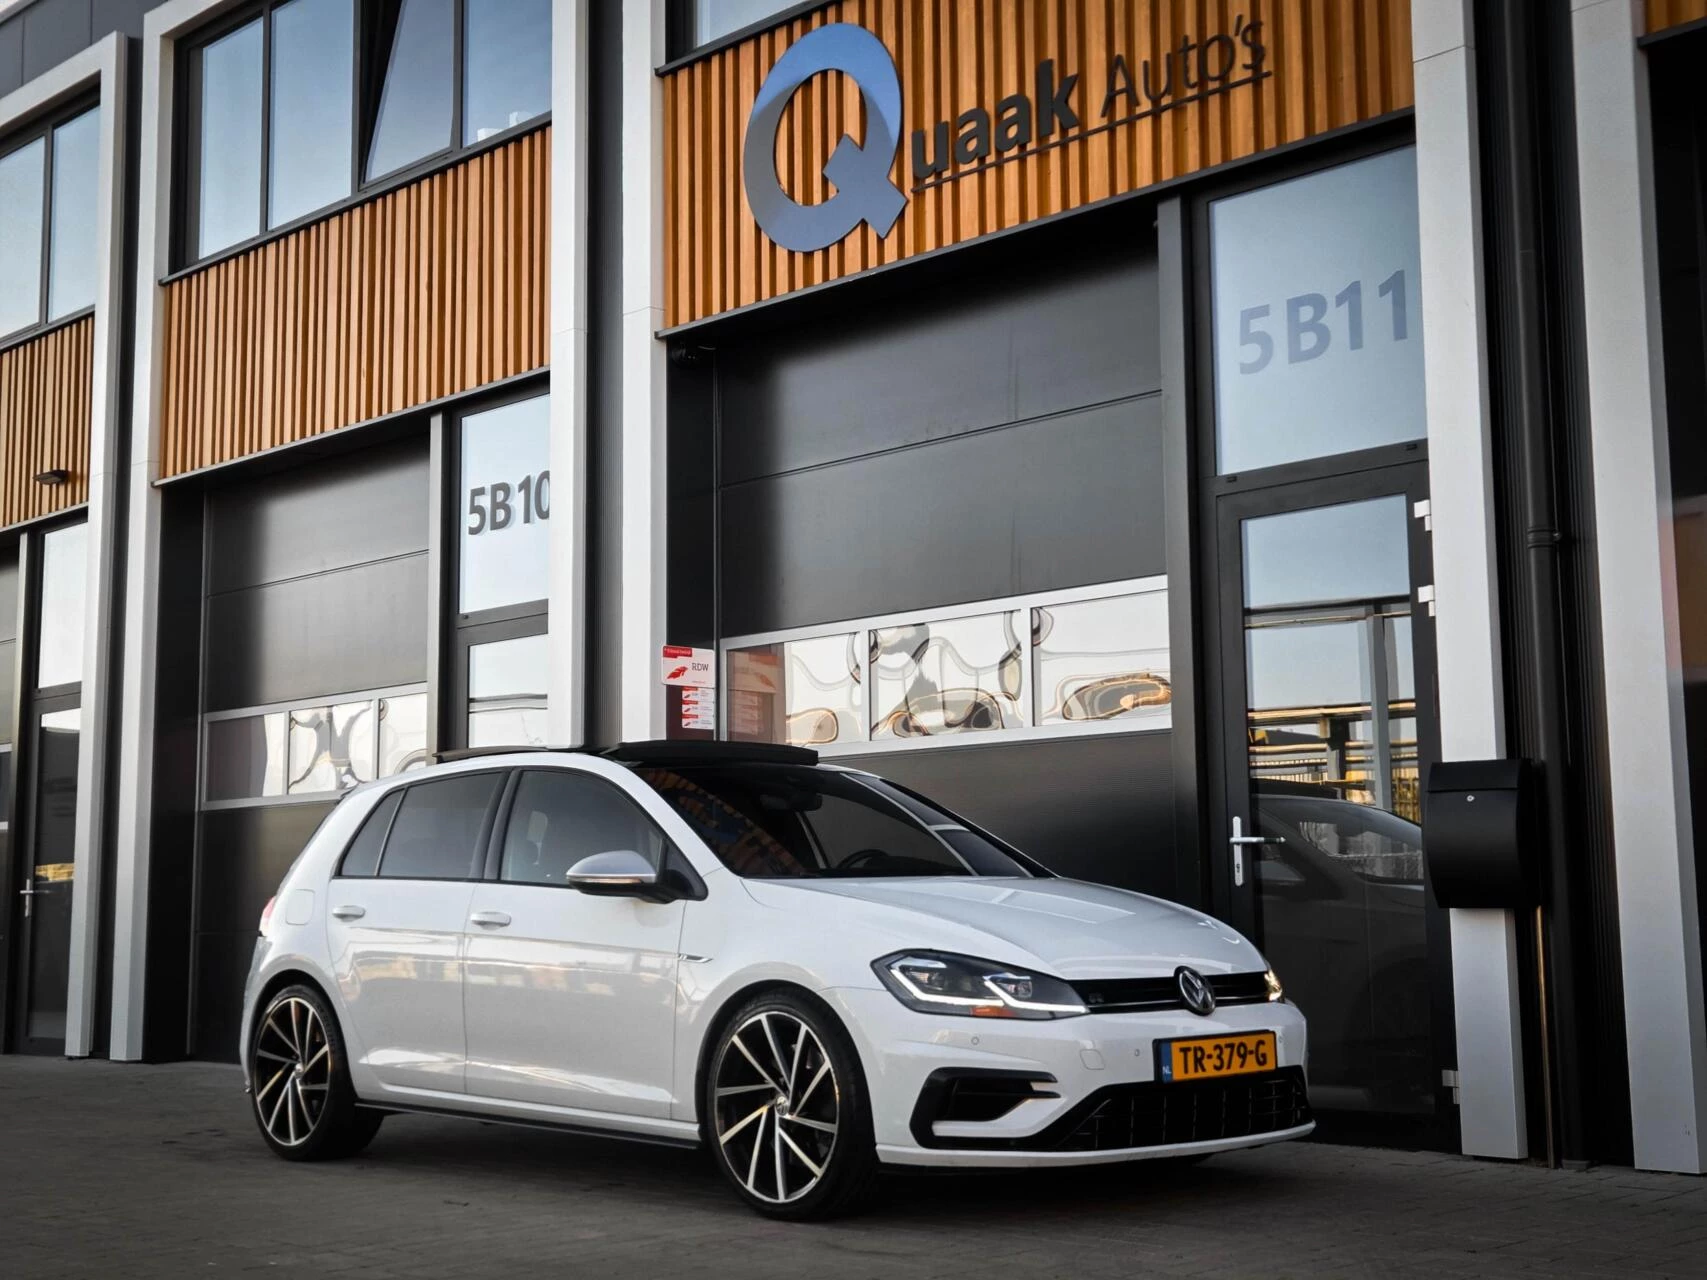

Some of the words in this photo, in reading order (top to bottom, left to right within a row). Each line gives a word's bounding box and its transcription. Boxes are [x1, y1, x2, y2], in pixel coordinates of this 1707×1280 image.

[743, 22, 1079, 253] Quaak
[1100, 15, 1265, 118] Auto's
[1239, 269, 1408, 375] 5B11
[468, 470, 550, 535] 5B10
[691, 662, 709, 672] RDW
[1179, 1040, 1267, 1074] TR-379-G
